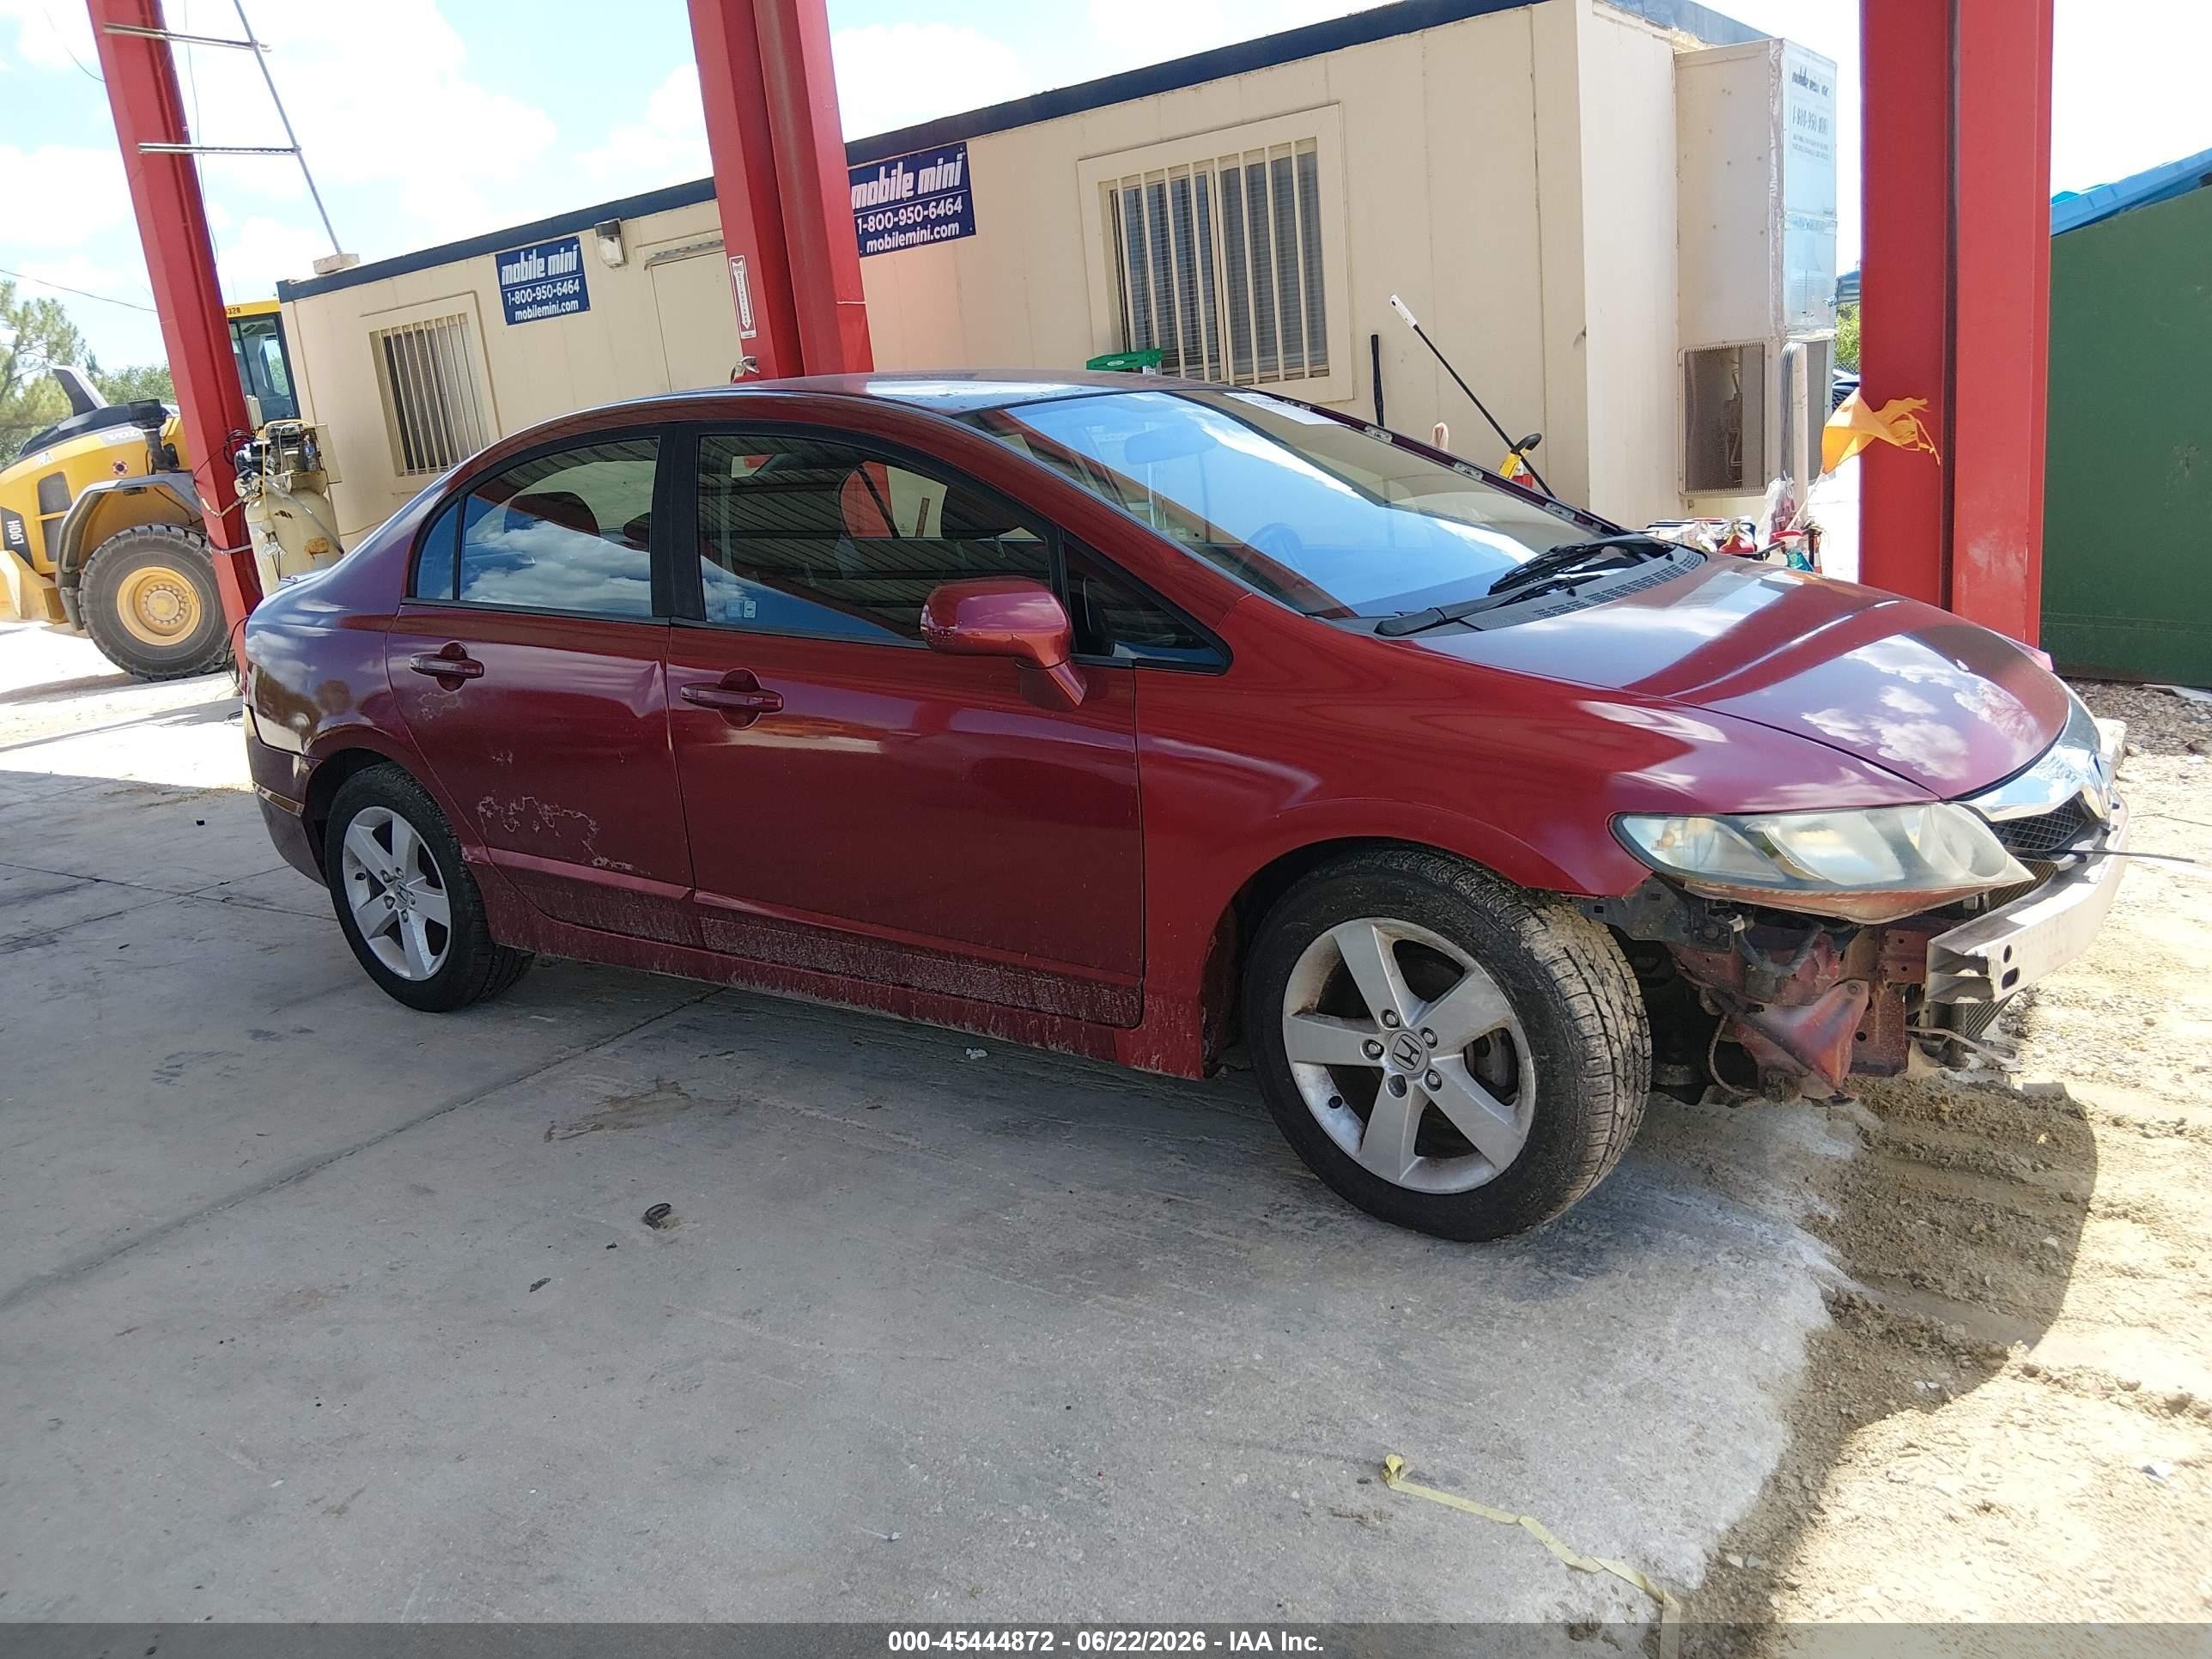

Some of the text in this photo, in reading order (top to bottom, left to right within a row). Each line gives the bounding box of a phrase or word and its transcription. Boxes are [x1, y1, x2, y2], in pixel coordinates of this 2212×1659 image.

[851, 153, 963, 210] mobile mini
[858, 196, 963, 235] 1-800-950-6464
[866, 222, 959, 253] mobilemini.com
[501, 244, 578, 286] mobile mini
[507, 278, 580, 307] 1-800-950-6464
[515, 300, 580, 321] mobilemini.com
[6, 520, 25, 545] L90H
